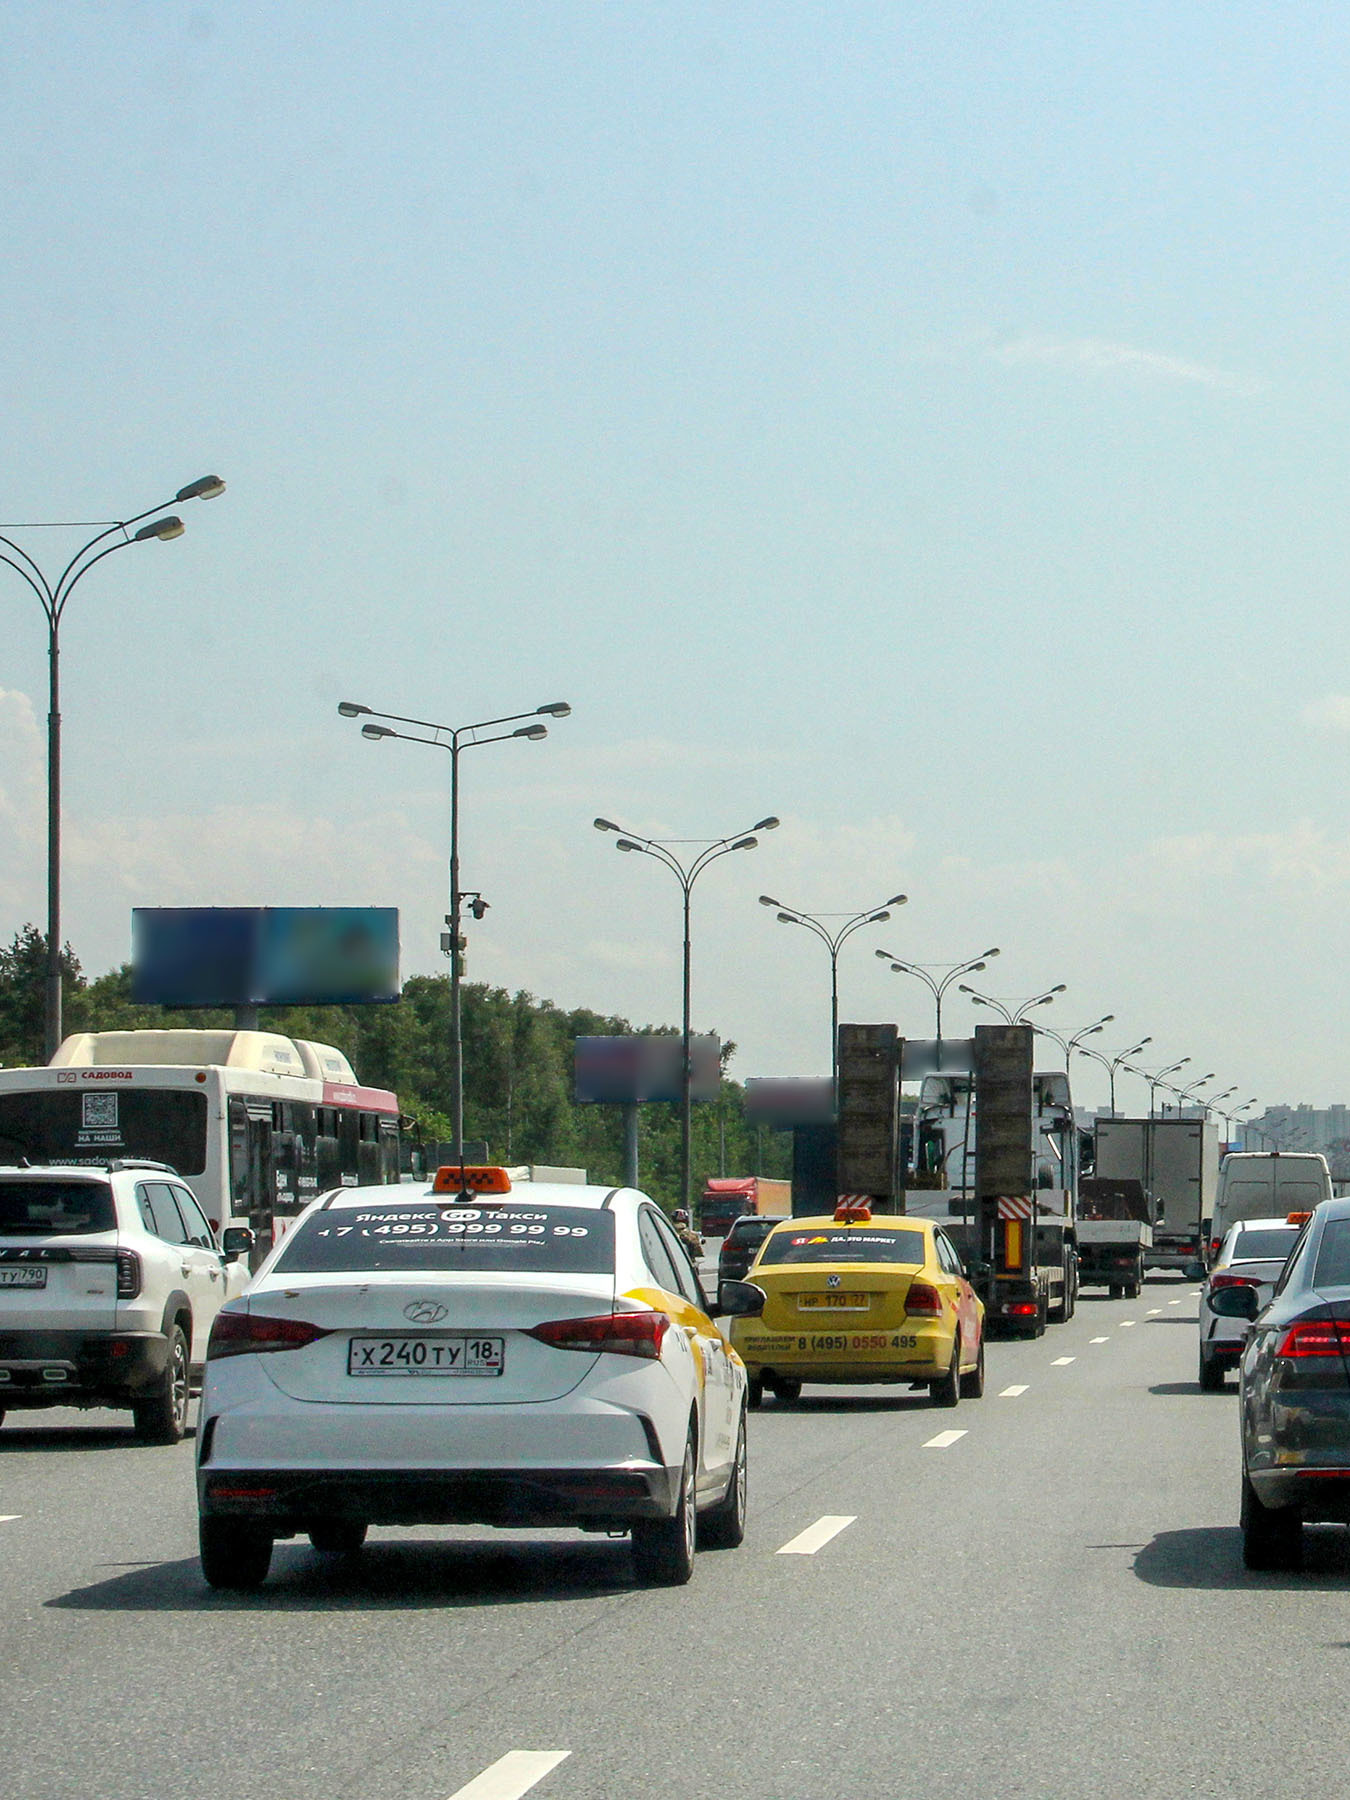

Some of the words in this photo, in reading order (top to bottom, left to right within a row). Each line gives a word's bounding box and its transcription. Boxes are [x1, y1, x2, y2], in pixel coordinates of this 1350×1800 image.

[81, 1071, 133, 1080] САДОВОД
[93, 1134, 121, 1142] НАШИ
[355, 1212, 437, 1223] Яндекс
[486, 1211, 548, 1221] Такси
[448, 1224, 502, 1235] 999
[509, 1225, 545, 1236] 99
[553, 1226, 588, 1238] 99
[798, 1336, 807, 1350] 8
[811, 1336, 848, 1351] (495)
[852, 1336, 887, 1348] 0550
[891, 1335, 917, 1348] 495
[469, 1341, 493, 1359] 18
